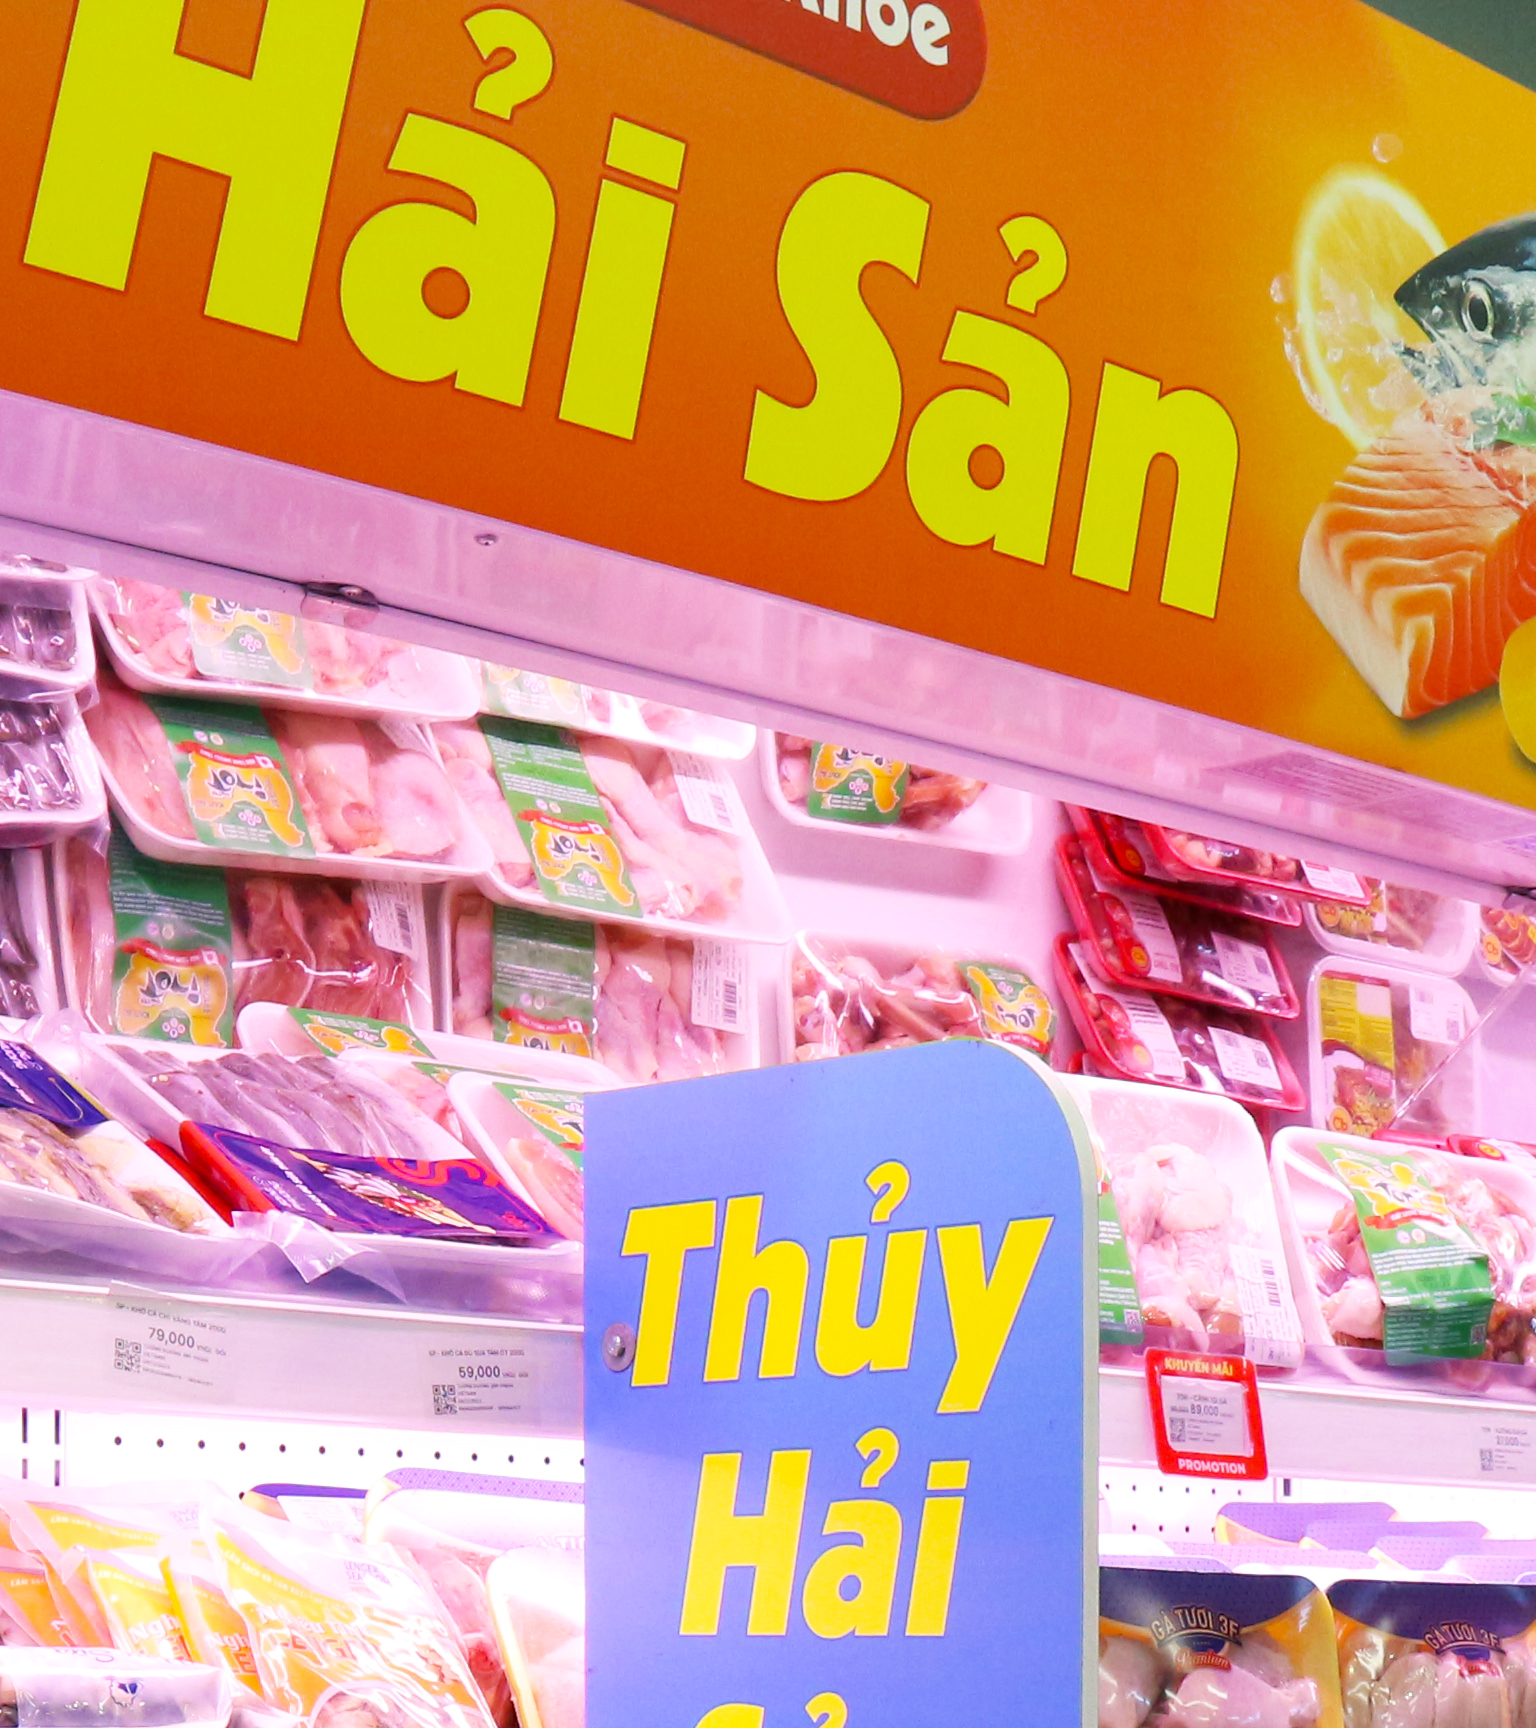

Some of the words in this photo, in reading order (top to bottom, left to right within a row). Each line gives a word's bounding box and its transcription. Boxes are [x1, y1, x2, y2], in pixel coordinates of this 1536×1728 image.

[21, 0, 688, 442] Hải
[741, 169, 1241, 620] Sản
[619, 1159, 1056, 1416] Thủy
[147, 1326, 196, 1351] 79,000
[458, 1364, 501, 1381] 59,000
[1164, 1355, 1210, 1376] KHUYẾN
[1211, 1360, 1234, 1377] MÃI
[1178, 1458, 1247, 1476] PROMOTION
[678, 1426, 970, 1639] Hải
[1150, 1608, 1177, 1640] GÀ
[1178, 1605, 1214, 1630] TƯƠI
[1217, 1614, 1240, 1637] 3F
